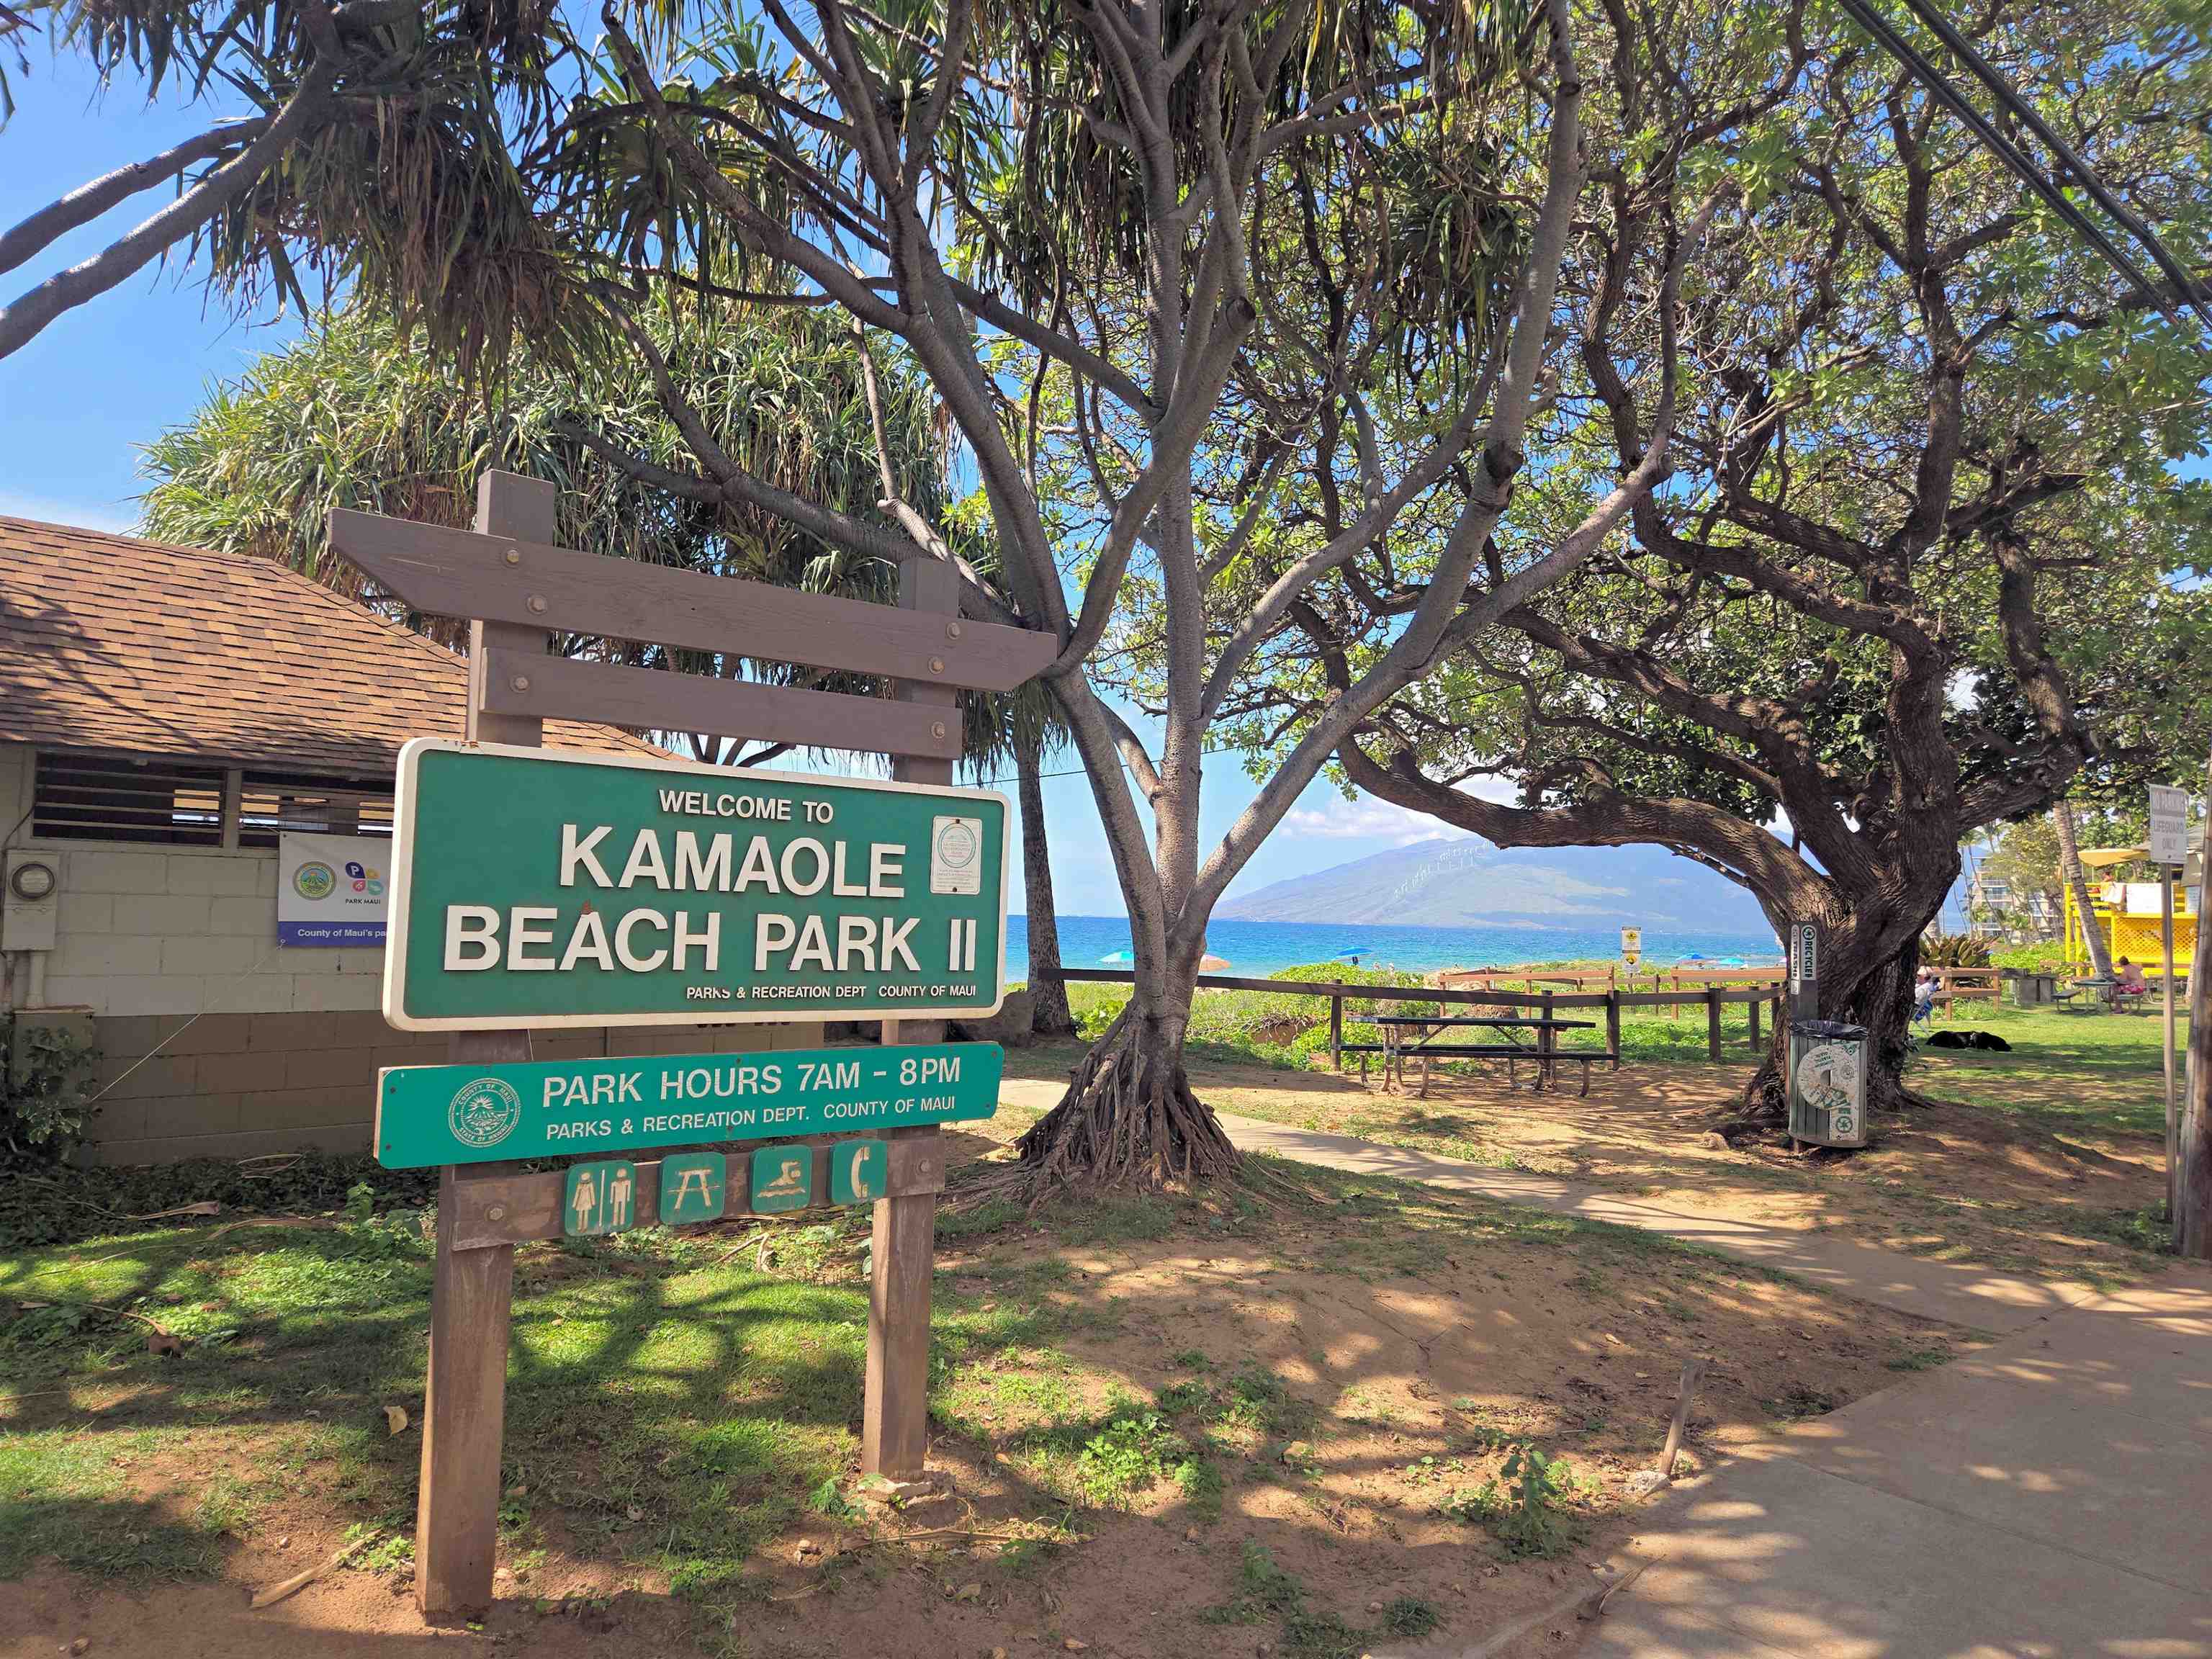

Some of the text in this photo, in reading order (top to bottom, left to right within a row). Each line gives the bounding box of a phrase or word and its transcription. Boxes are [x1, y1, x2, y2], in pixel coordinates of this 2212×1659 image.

[659, 789, 834, 824] WELCOME TO
[561, 824, 907, 898] KAMAOLE
[297, 928, 331, 939] County
[333, 928, 343, 937] of
[444, 906, 976, 972] BEACH PARK II
[1804, 940, 1813, 978] RECYCLED
[686, 984, 976, 999] PARKS & RECREATION DEPT COUNTY OF MAUI
[458, 1084, 483, 1105] COUNTY
[542, 1072, 643, 1107] PARK
[660, 1064, 783, 1100] HOURS
[797, 1061, 860, 1092] 7AM
[899, 1056, 961, 1086] 8PM
[546, 1095, 956, 1141] PARKS & RECREATION DEPT. COUNTY OF MAUI
